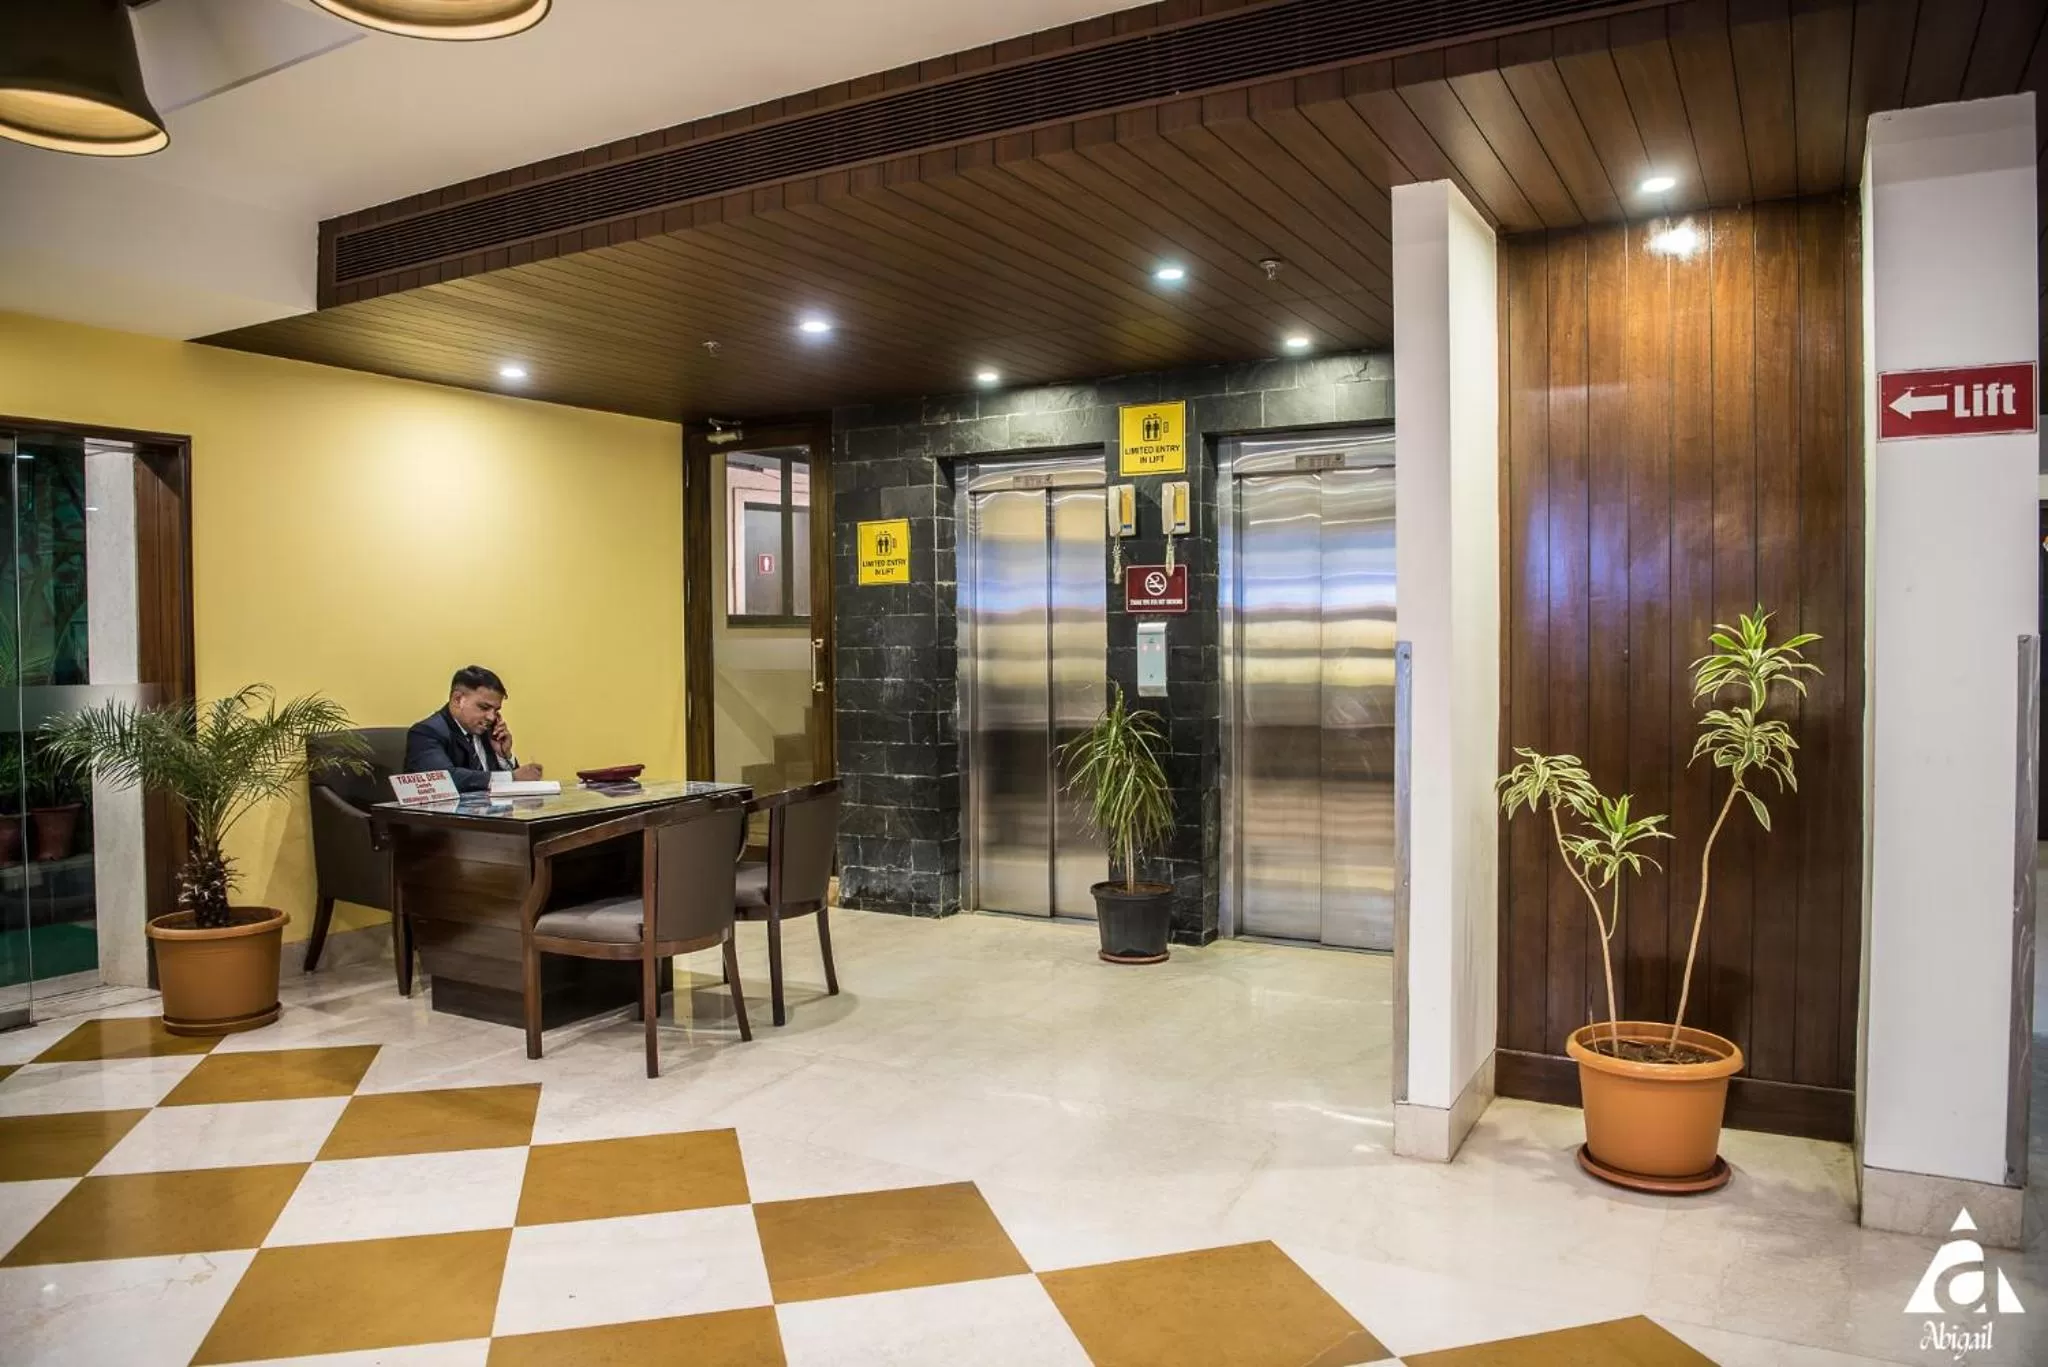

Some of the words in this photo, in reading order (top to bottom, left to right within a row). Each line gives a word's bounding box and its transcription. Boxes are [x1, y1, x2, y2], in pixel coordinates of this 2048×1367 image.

[1954, 383, 2016, 417] Lift
[1124, 446, 1154, 456] LIMITED
[1155, 444, 1181, 454] ENTRY
[1139, 456, 1149, 464] IN
[1149, 455, 1165, 464] LIFT
[396, 775, 426, 784] TRAVEL
